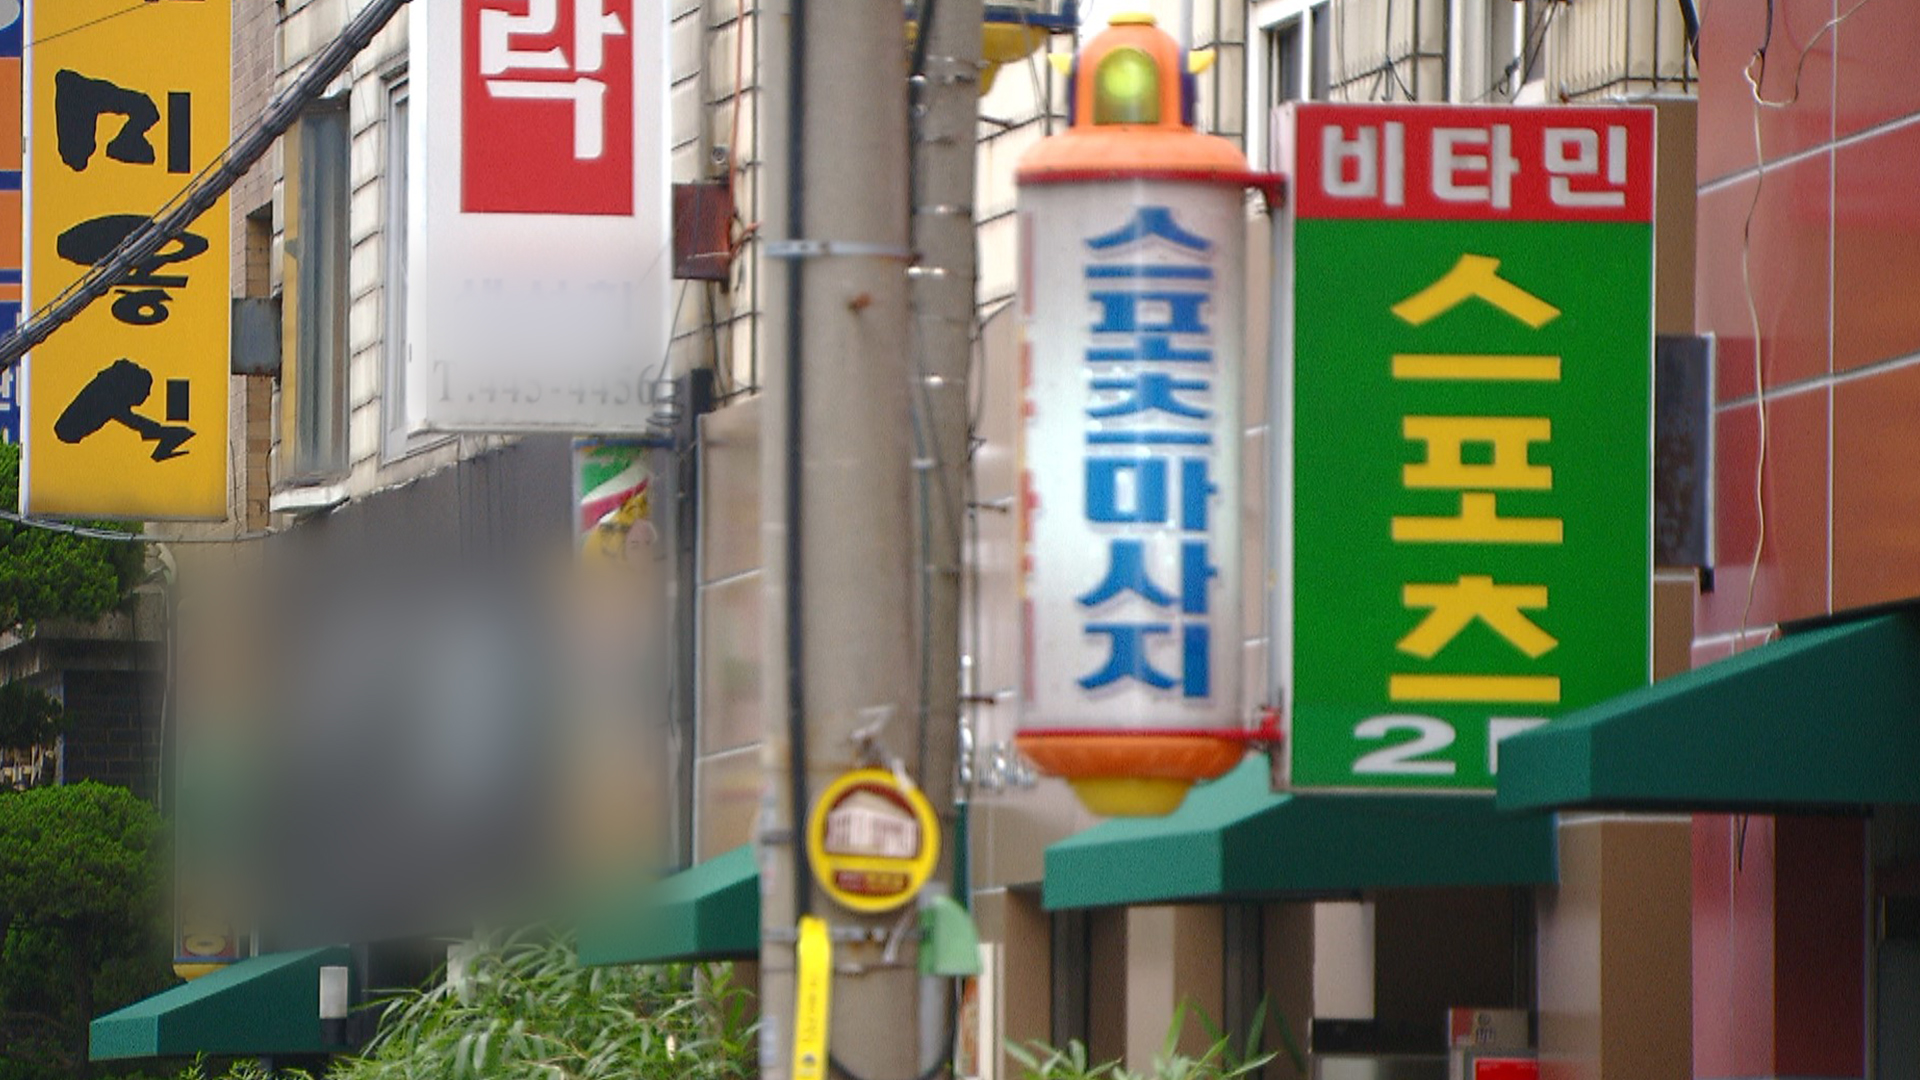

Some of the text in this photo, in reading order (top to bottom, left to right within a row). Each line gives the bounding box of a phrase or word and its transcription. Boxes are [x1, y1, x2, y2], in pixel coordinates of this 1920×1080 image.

[53, 68, 210, 463] 미용실
[1320, 120, 1628, 210] 비타민
[1390, 252, 1564, 703] 스포츠
